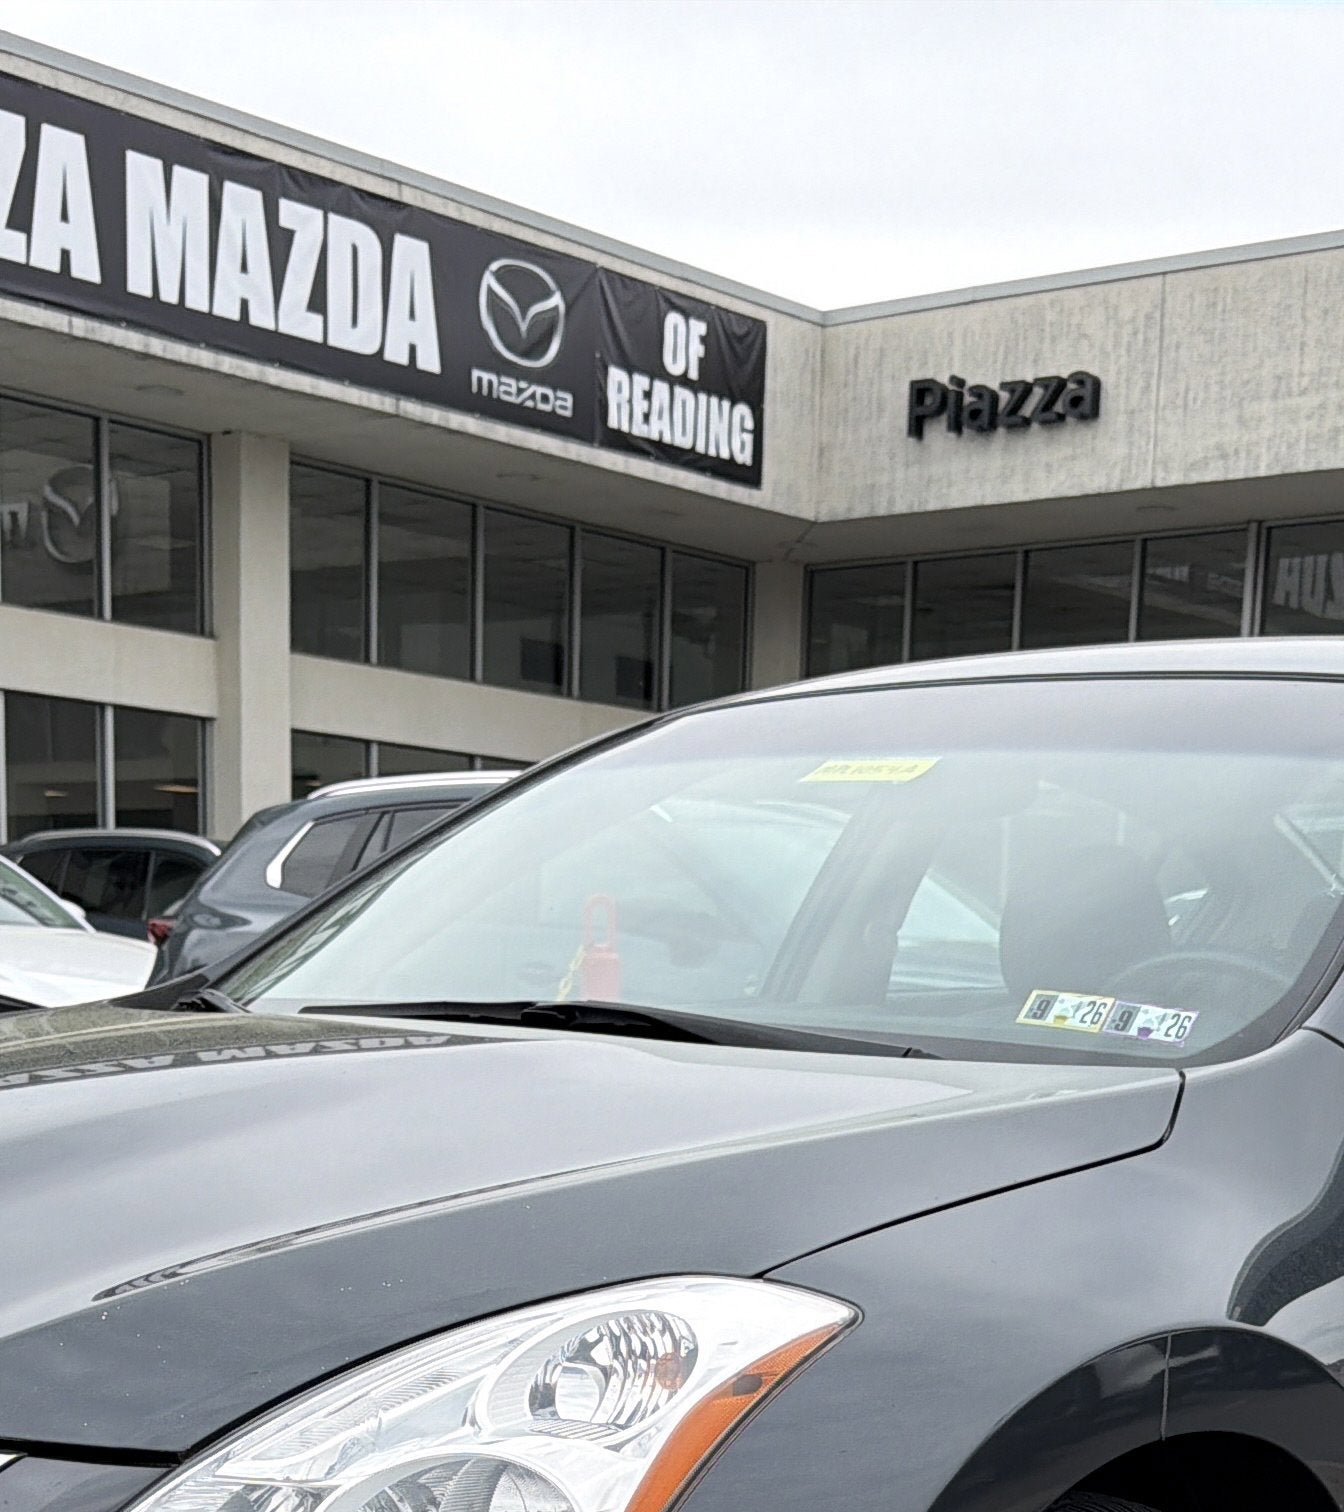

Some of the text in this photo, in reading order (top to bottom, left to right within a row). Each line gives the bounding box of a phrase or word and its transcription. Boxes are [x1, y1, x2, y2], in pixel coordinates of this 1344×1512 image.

[125, 148, 442, 375] MAZDA
[662, 310, 708, 381] OF
[471, 367, 574, 419] mazda
[607, 364, 755, 467] READING
[906, 370, 1102, 442] Piazza
[1031, 999, 1108, 1025] 9 26
[1114, 1009, 1193, 1040] 9 26
